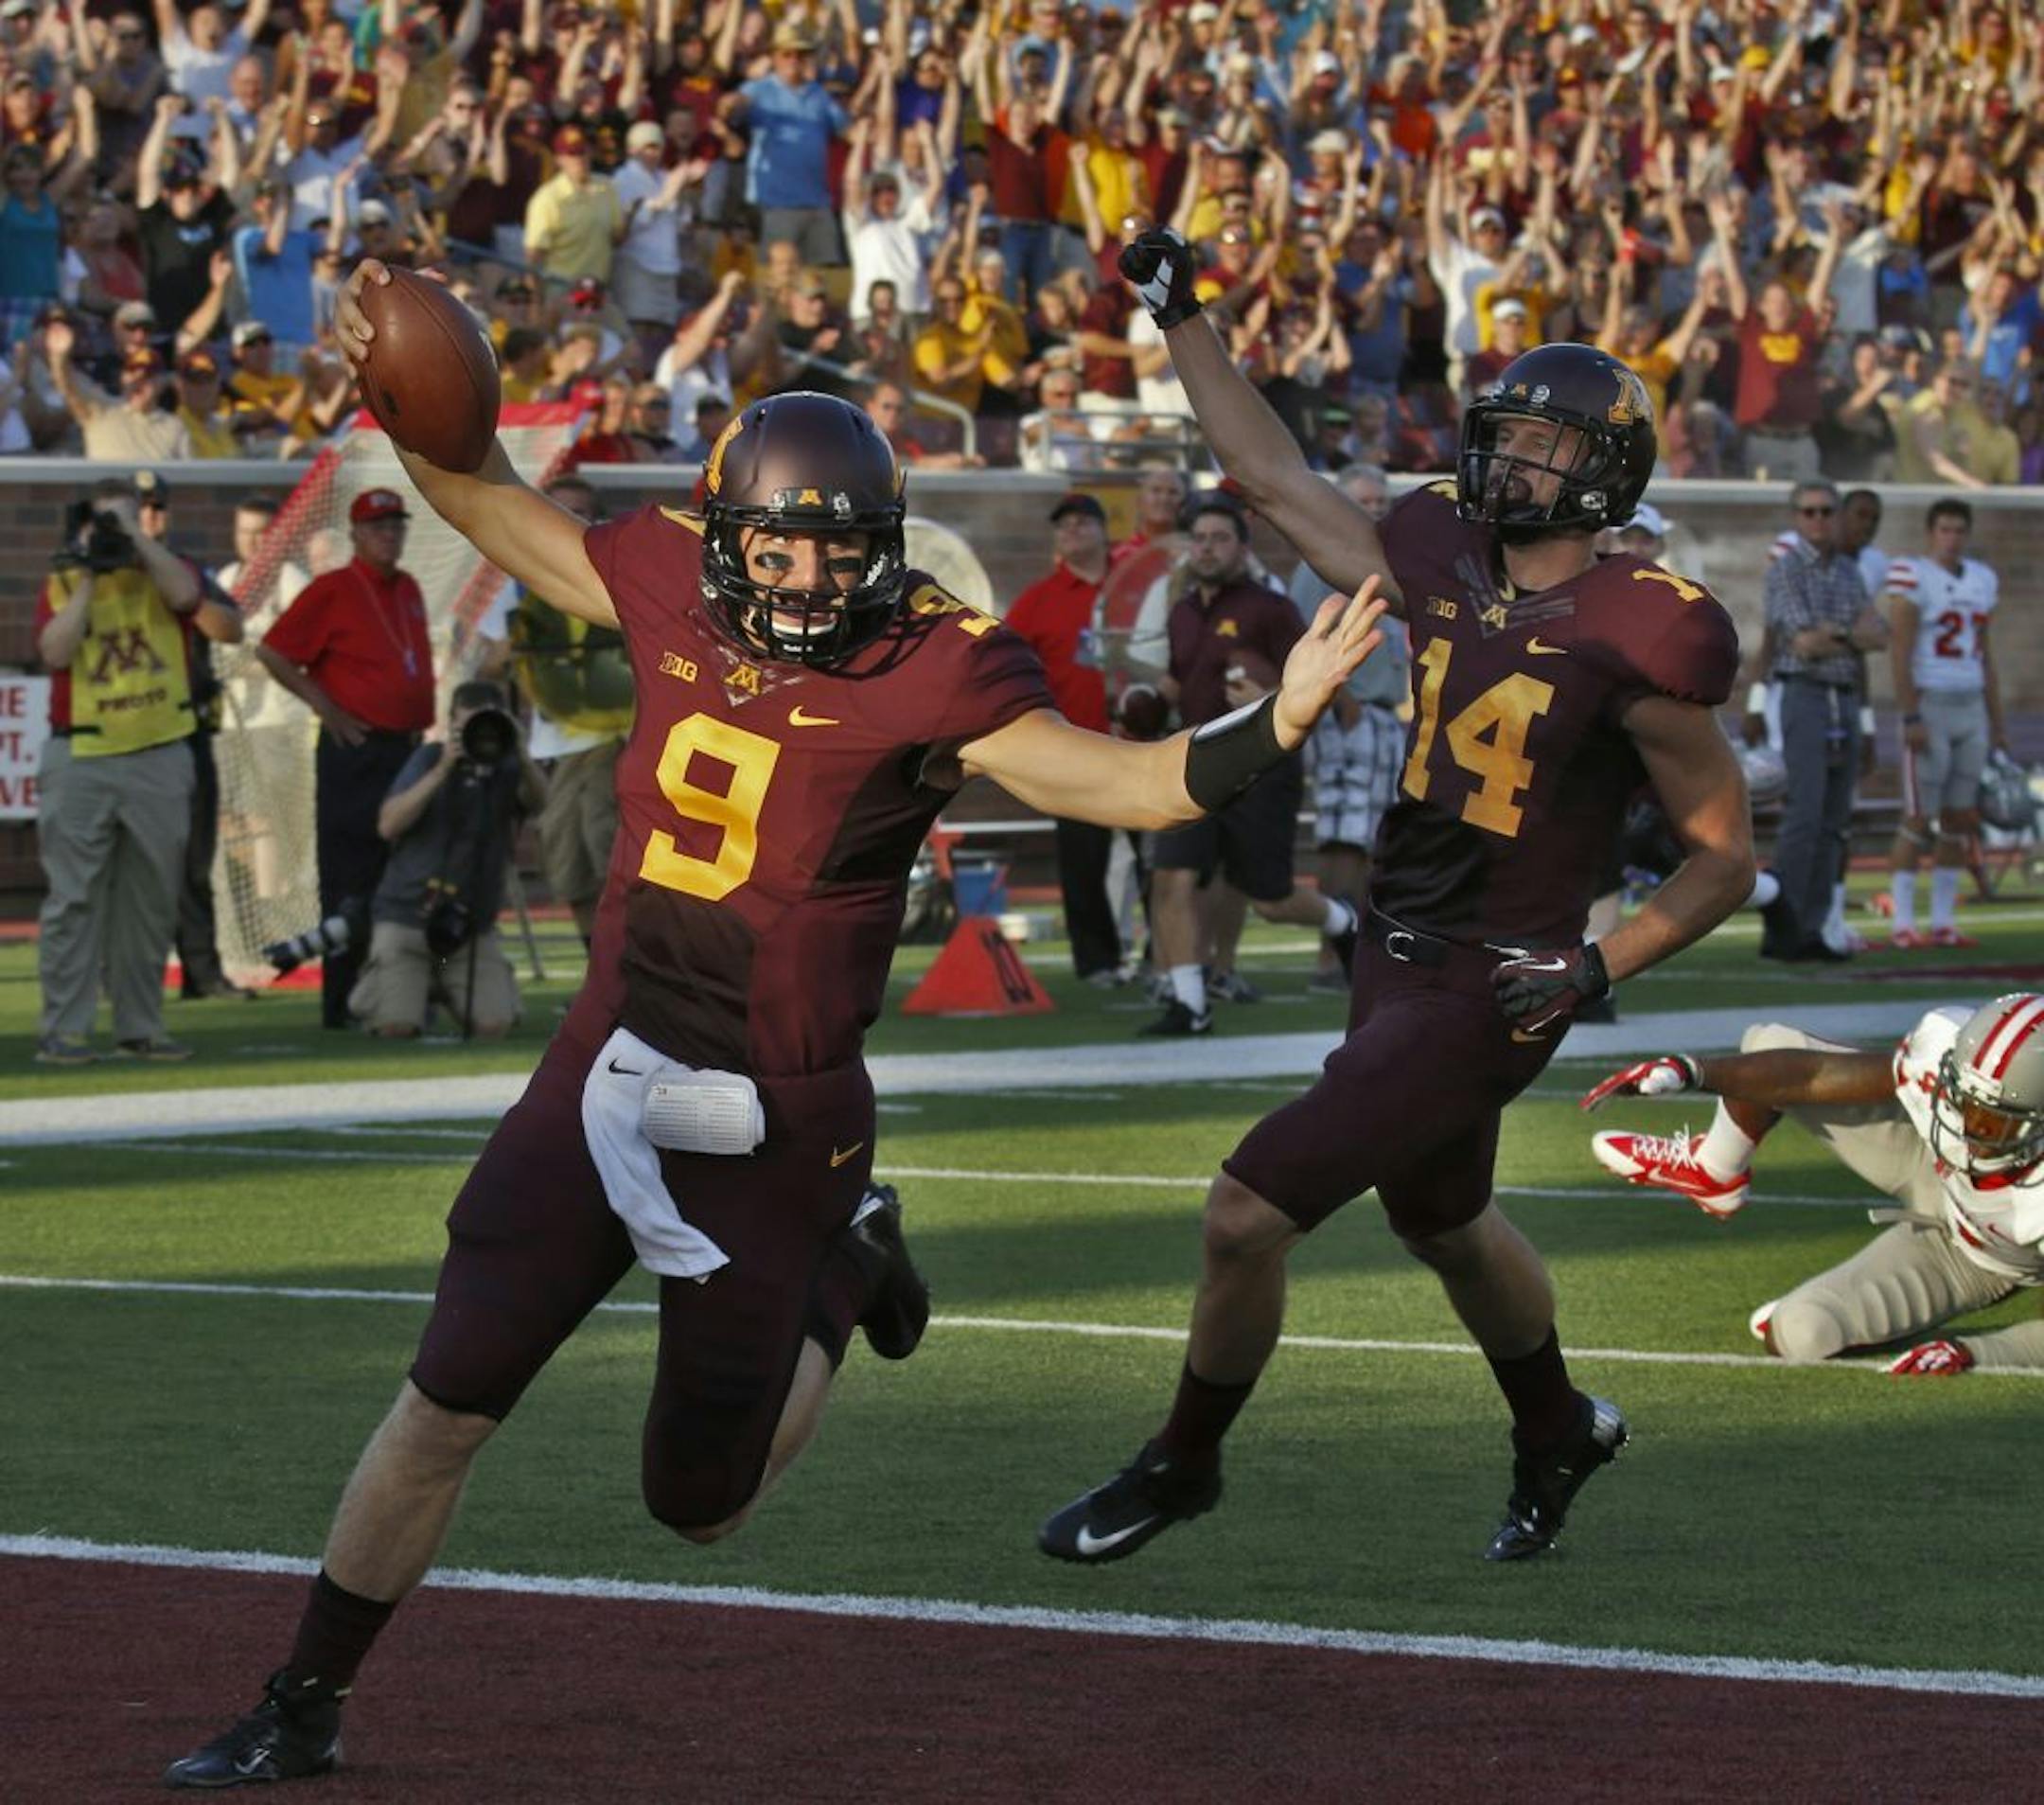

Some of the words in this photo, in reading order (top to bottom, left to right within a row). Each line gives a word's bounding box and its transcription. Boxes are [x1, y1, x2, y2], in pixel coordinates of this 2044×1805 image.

[0, 730, 35, 763] T.
[97, 688, 167, 713] PHOTO
[1402, 637, 1555, 838] 14
[638, 711, 782, 902] 9
